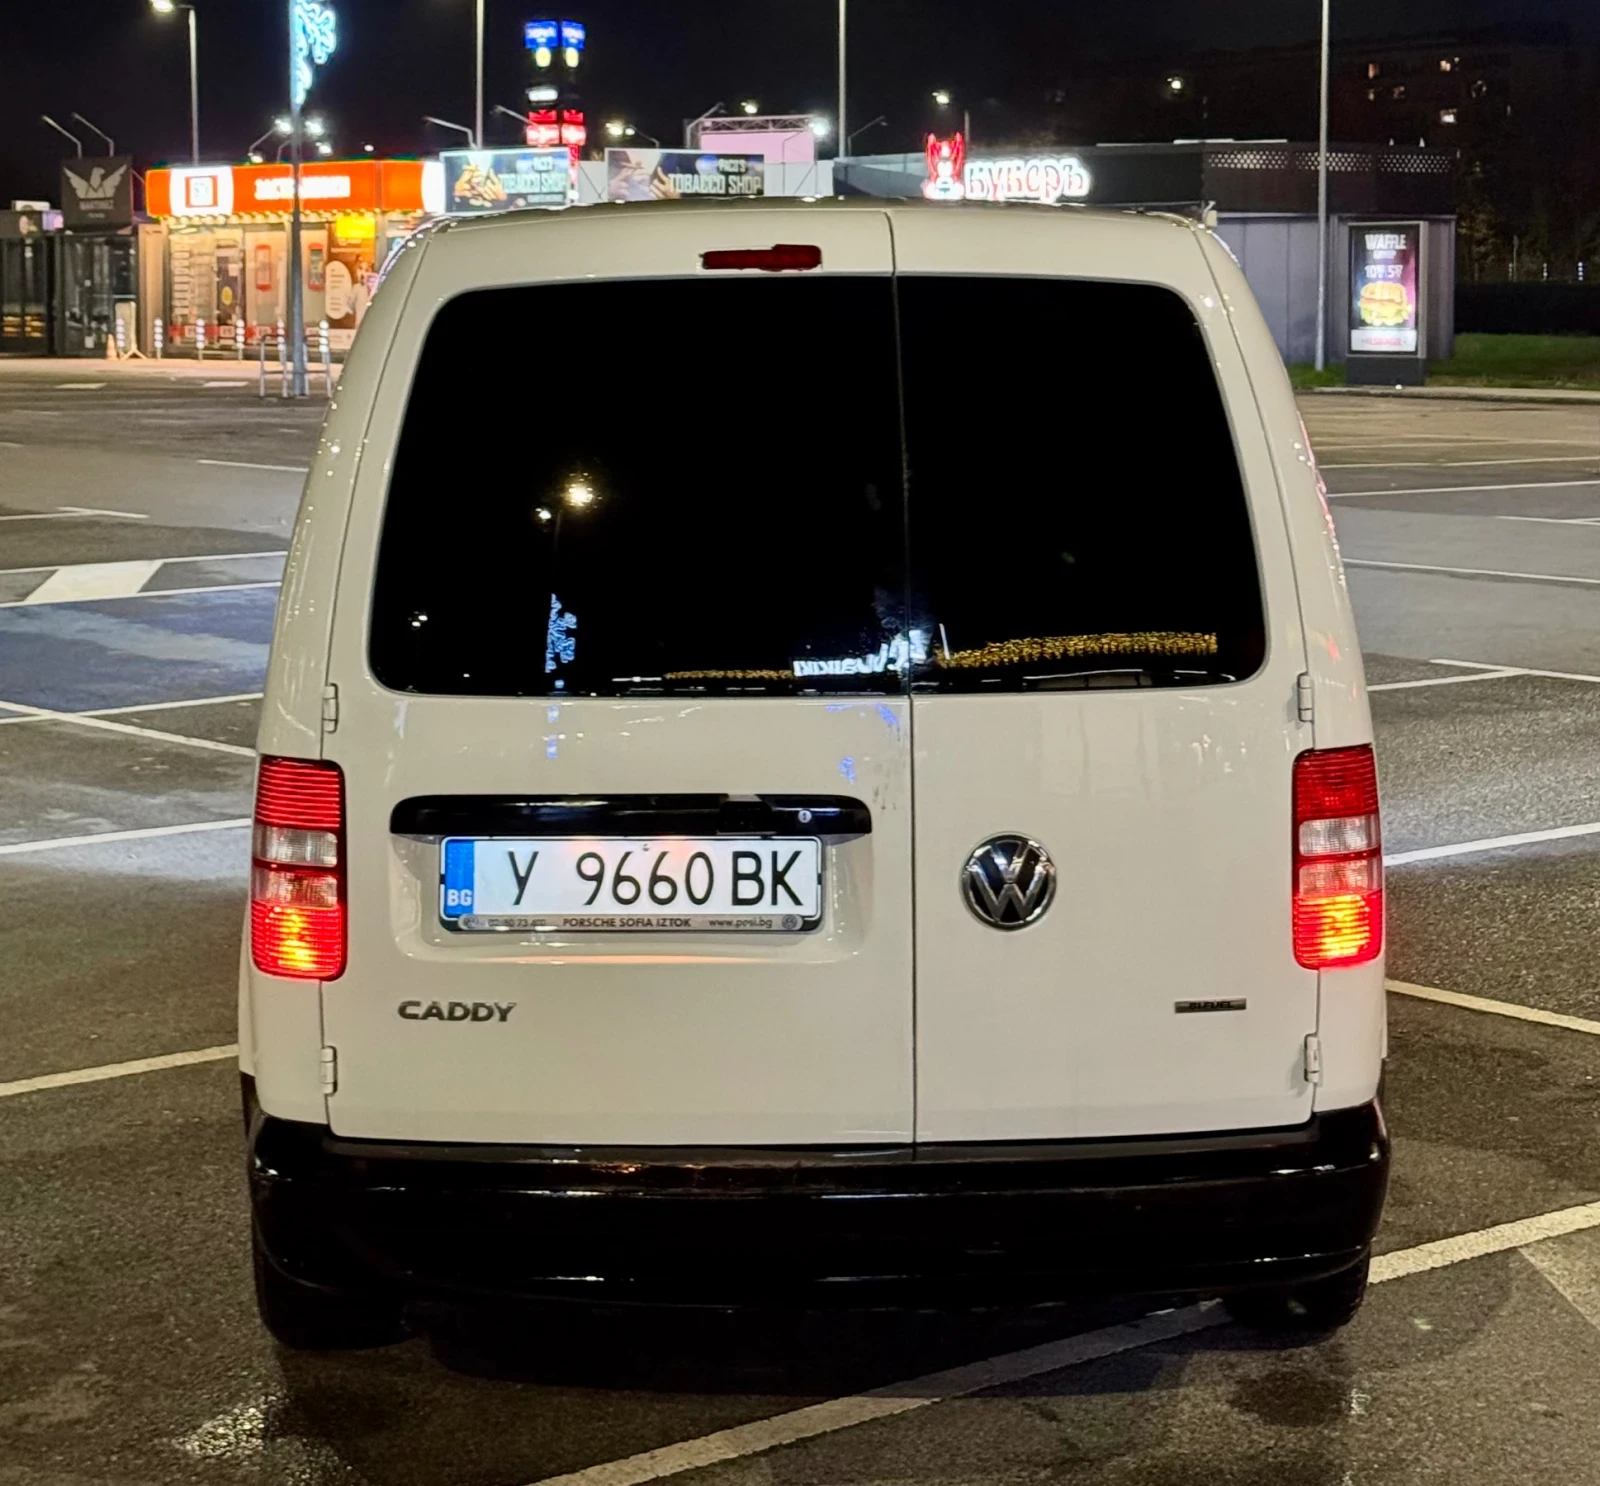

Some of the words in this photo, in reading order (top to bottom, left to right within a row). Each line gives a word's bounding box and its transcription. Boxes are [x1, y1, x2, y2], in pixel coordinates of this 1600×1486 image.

[668, 174, 726, 194] TOBACCO
[728, 174, 762, 194] SHOP
[1364, 234, 1407, 250] WAFFLE
[575, 850, 715, 906] 9660
[731, 850, 804, 907] BK
[447, 889, 473, 906] BG
[563, 917, 616, 927] PORSCHE
[619, 917, 653, 927] SOFIA
[656, 917, 692, 927] IZTOK
[397, 1000, 518, 1022] CADDY
